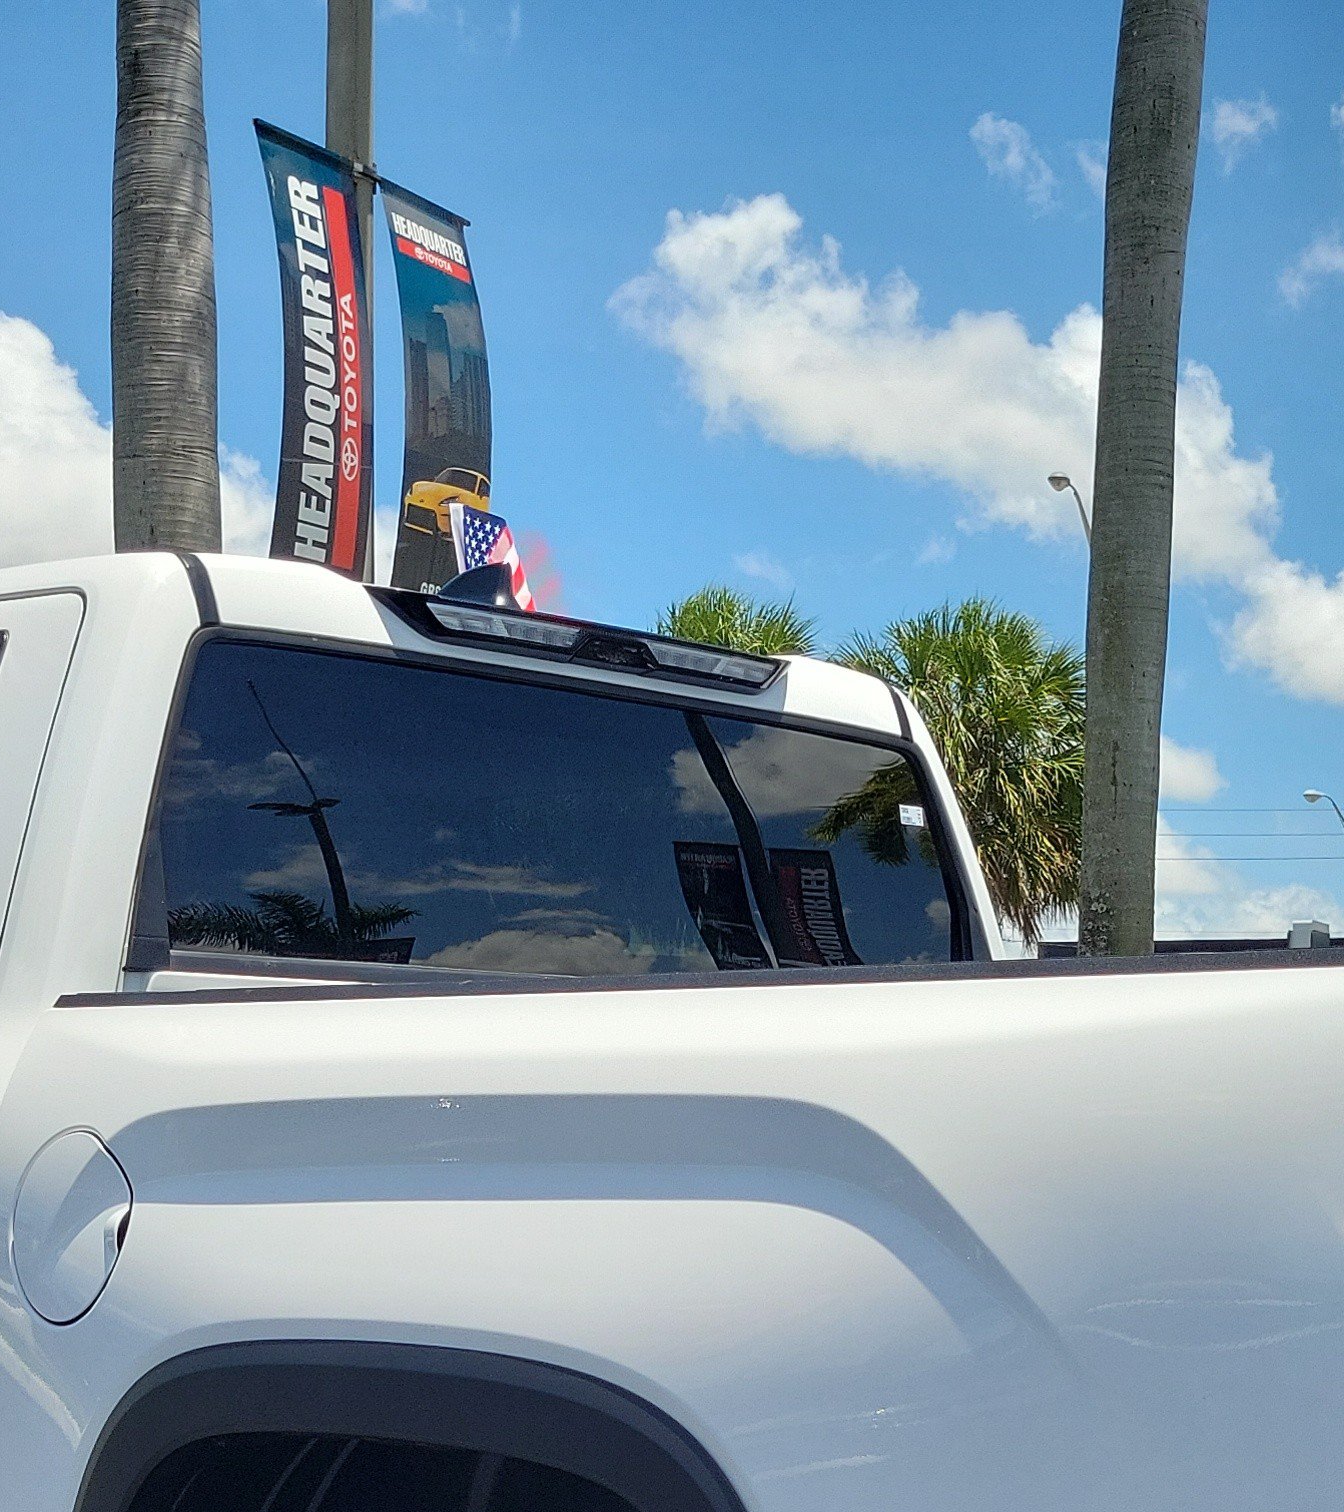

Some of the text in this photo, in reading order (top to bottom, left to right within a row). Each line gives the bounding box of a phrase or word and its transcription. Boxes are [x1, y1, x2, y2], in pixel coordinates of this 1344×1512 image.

[391, 211, 467, 267] HEADQUARTER
[423, 251, 453, 273] TOYOTA
[287, 174, 340, 564] HEADQUARTER
[340, 292, 358, 431] TOYOTA
